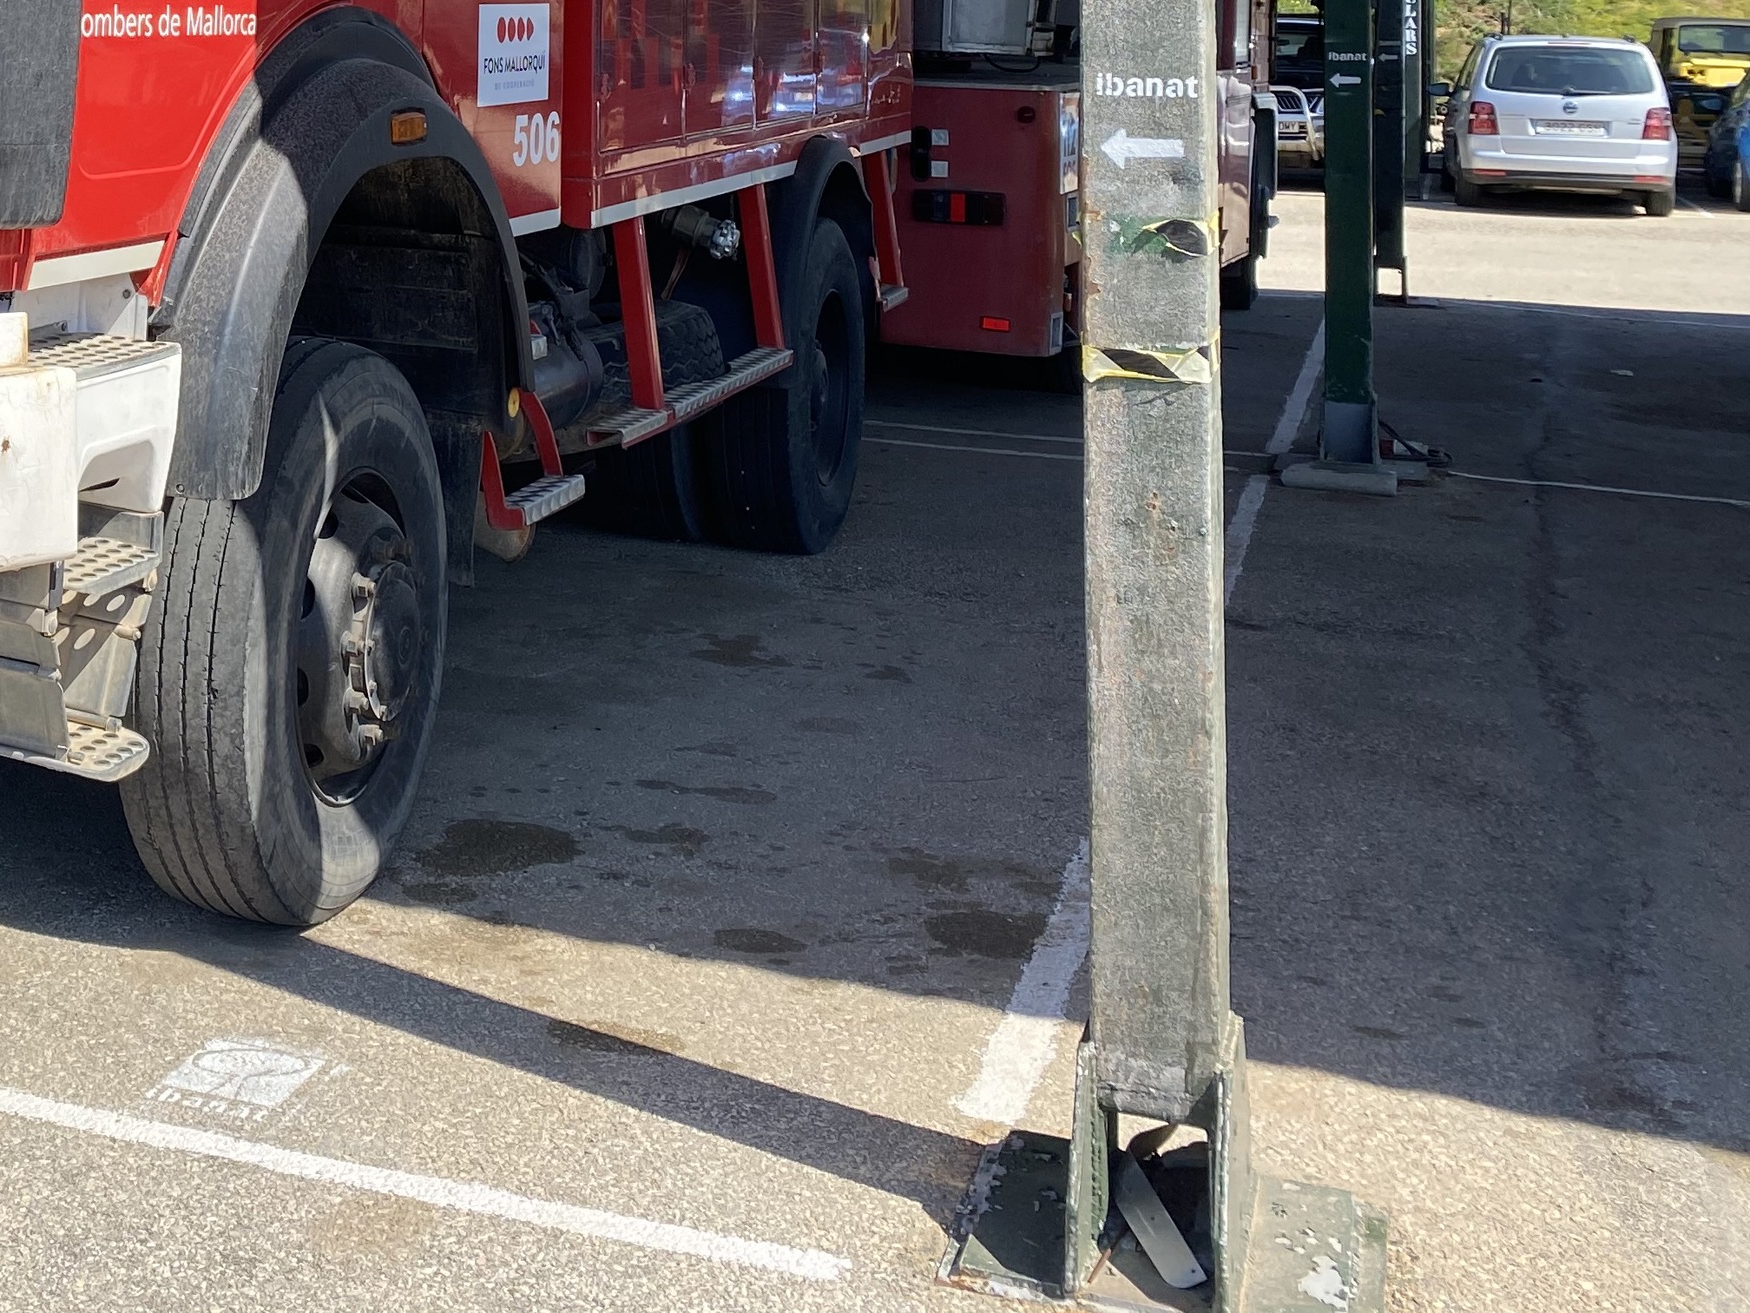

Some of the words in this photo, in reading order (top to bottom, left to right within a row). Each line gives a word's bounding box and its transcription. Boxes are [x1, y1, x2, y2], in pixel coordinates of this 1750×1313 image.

[80, 3, 153, 38] ombers
[158, 4, 181, 37] de
[186, 4, 257, 37] Mallorca
[483, 57, 504, 75] FONS
[1328, 51, 1367, 62] ibanat
[1096, 72, 1199, 99] ibanat
[512, 111, 560, 167] 506
